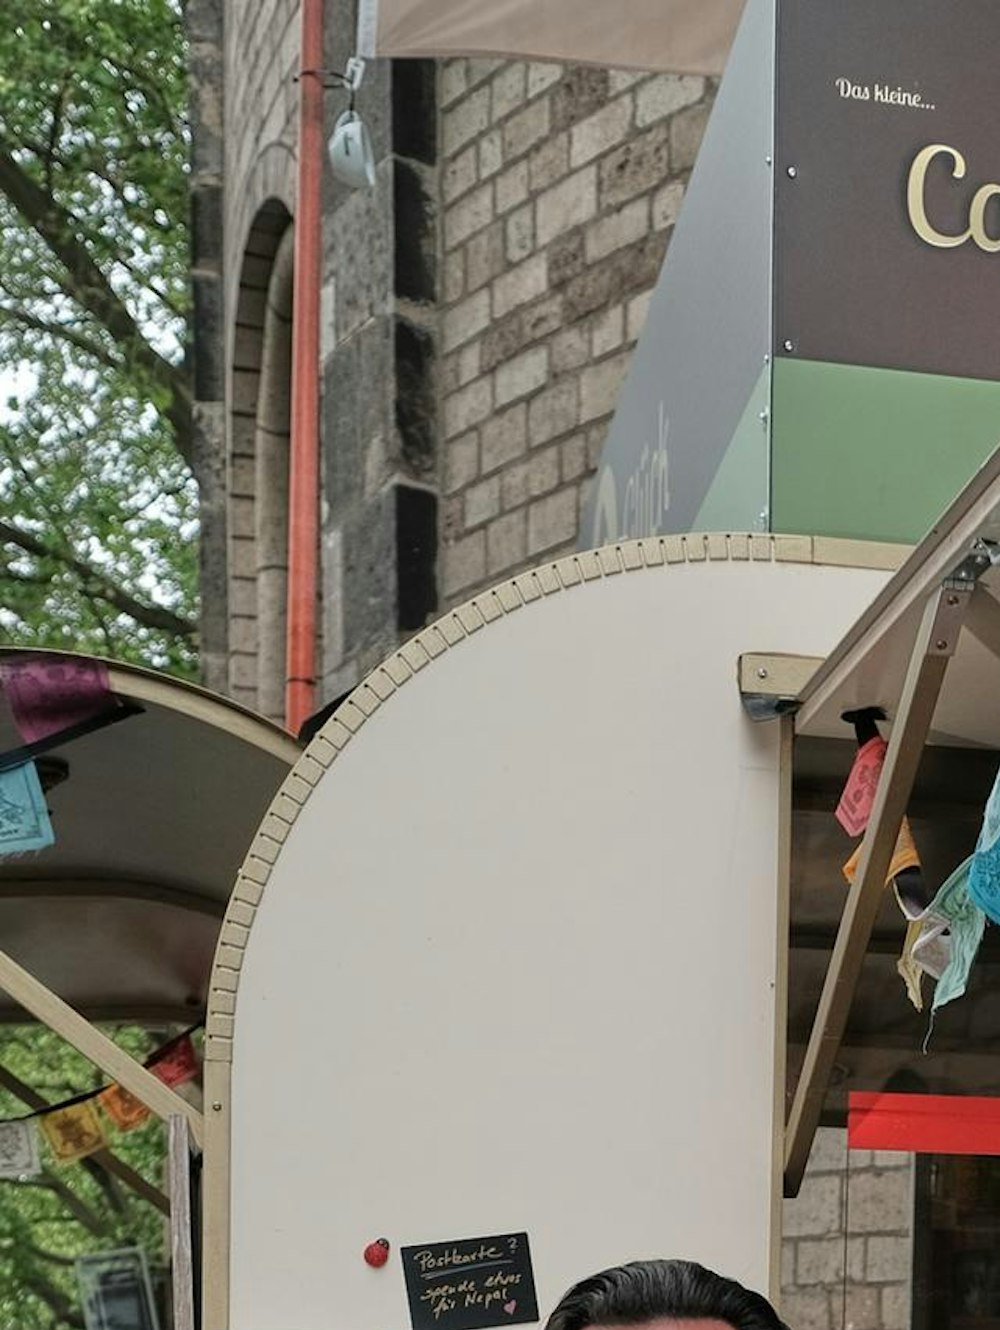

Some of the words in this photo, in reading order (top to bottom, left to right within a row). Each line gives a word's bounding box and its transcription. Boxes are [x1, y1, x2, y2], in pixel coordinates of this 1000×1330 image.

[835, 77, 870, 100] Das
[874, 84, 935, 110] kleine...
[414, 1245, 504, 1272] Postkarte
[421, 1280, 476, 1305] spende
[485, 1271, 521, 1287] etwas
[465, 1288, 508, 1310] Nepal
